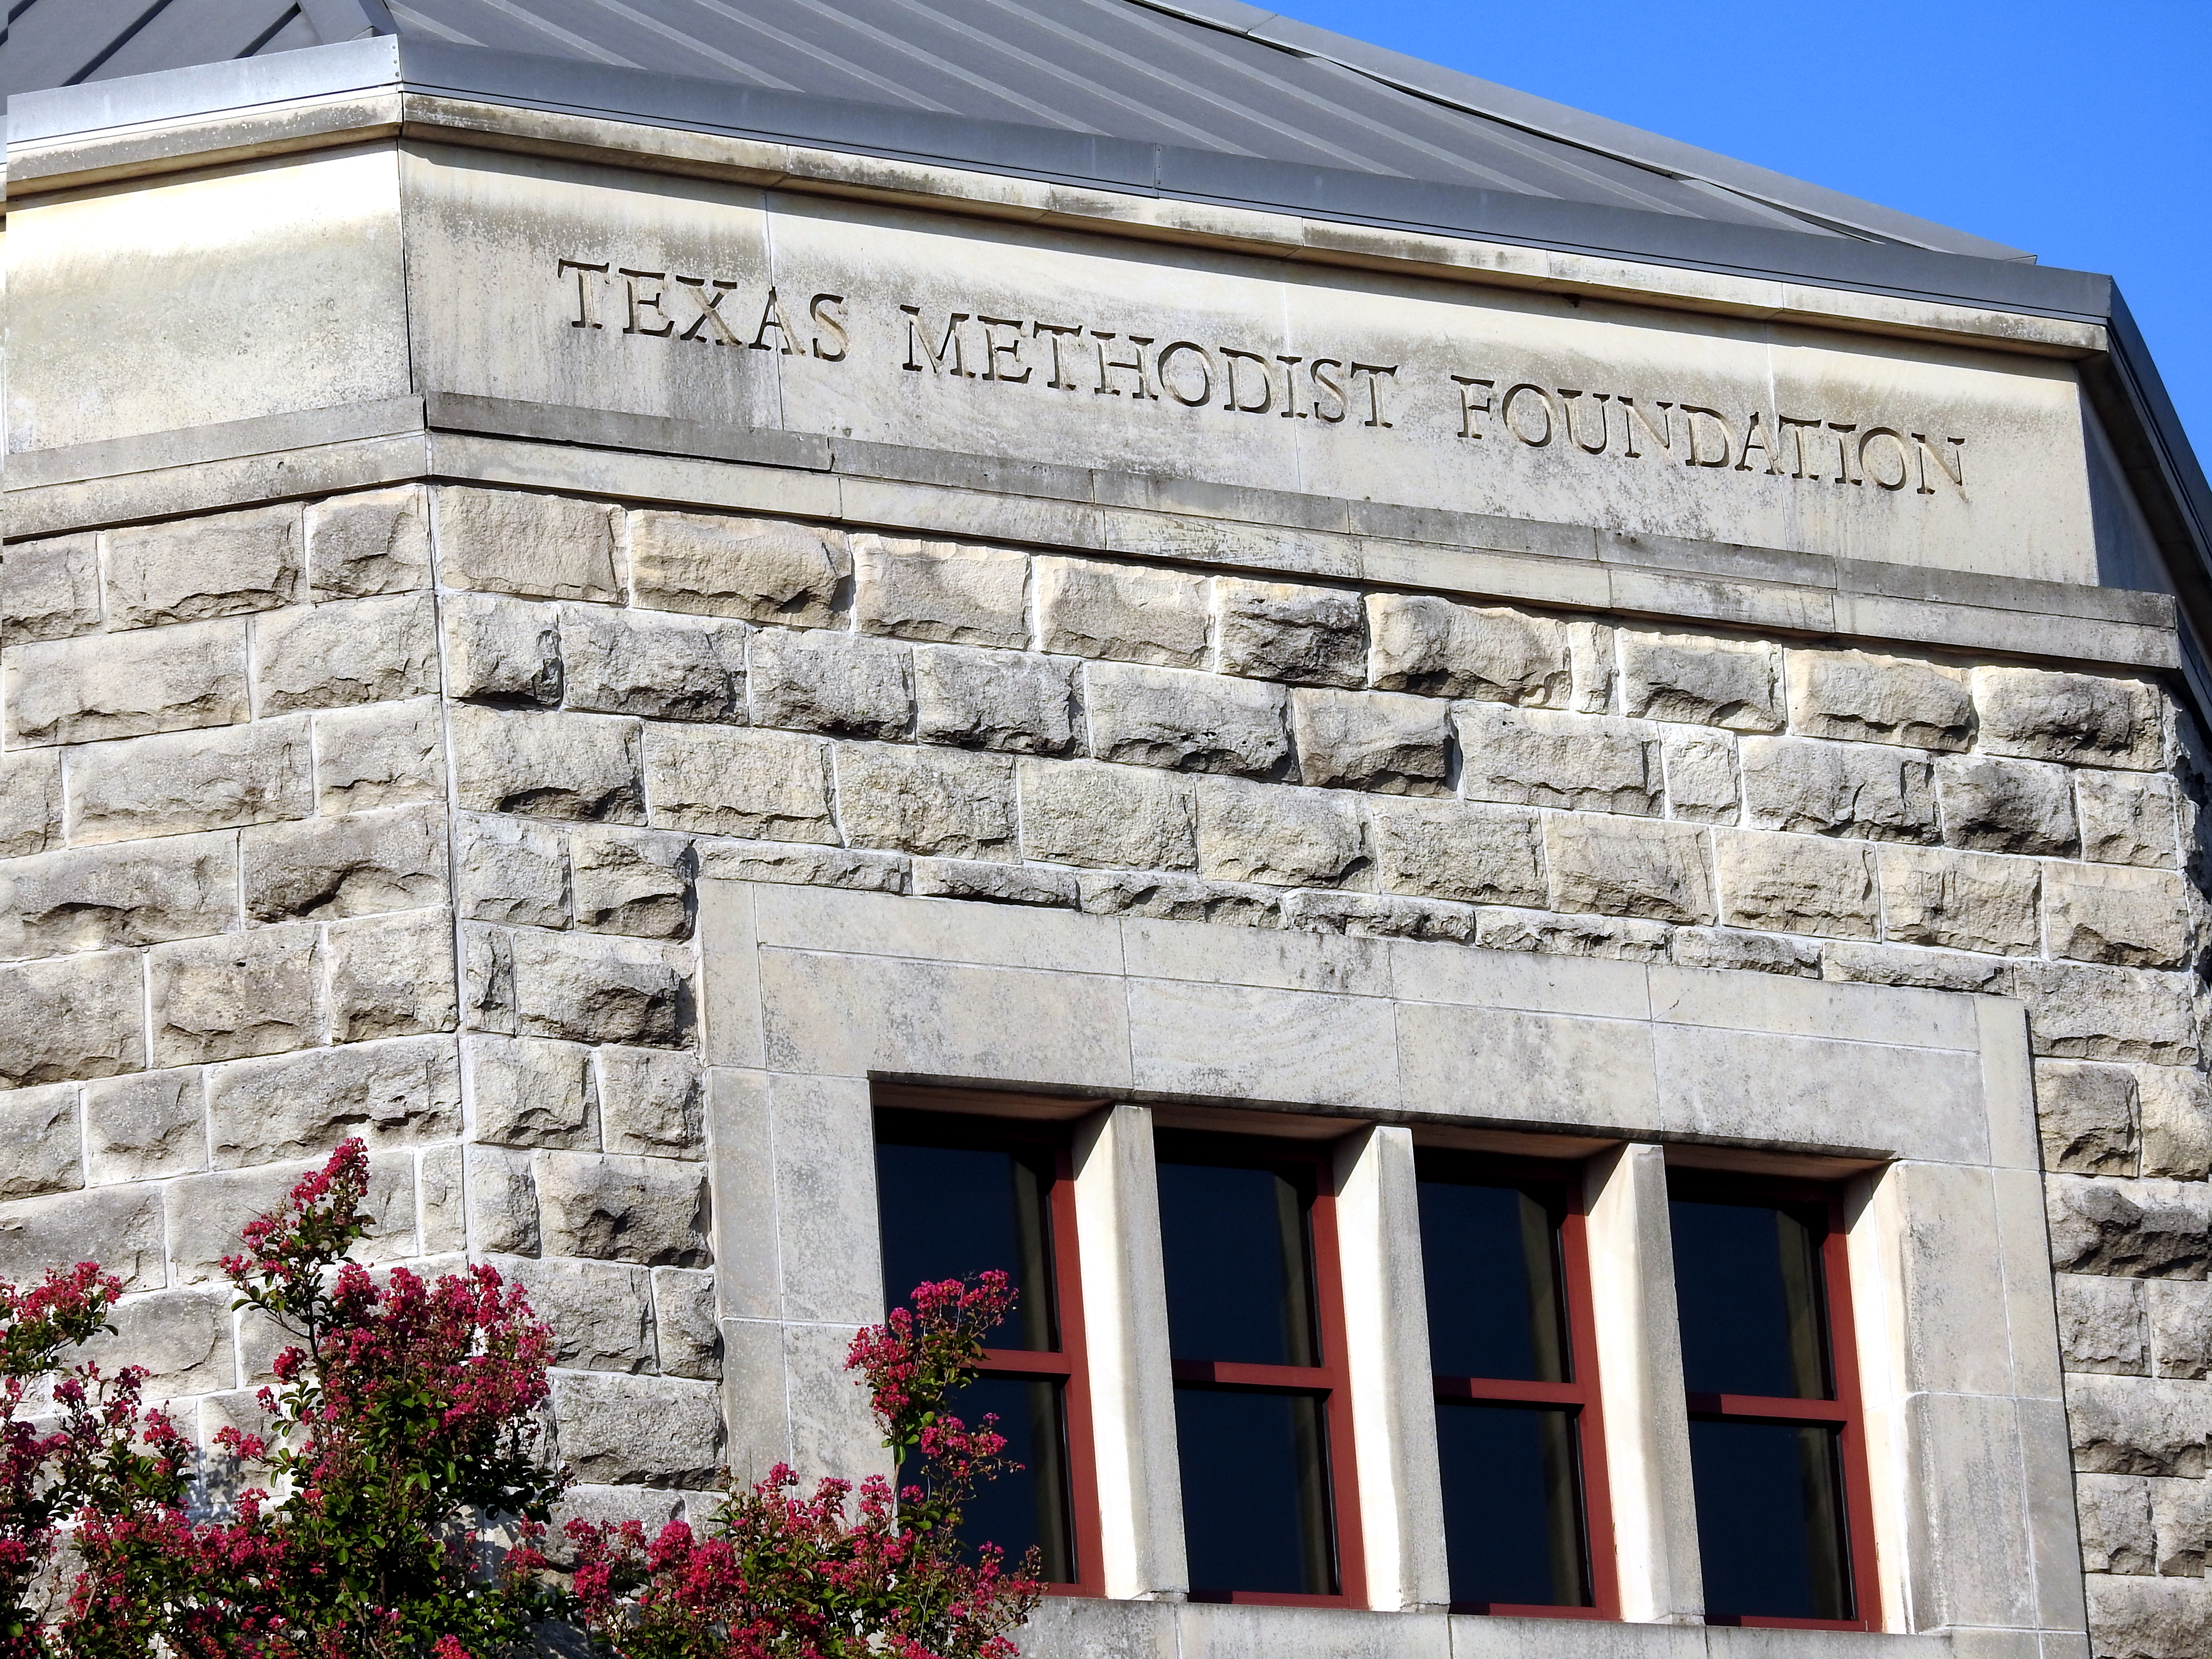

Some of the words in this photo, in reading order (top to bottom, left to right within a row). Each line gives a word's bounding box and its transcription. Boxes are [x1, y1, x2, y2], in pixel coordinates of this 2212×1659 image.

[558, 258, 851, 362] TEXAS
[900, 304, 1398, 429] METHODIST
[1451, 374, 1967, 503] FOUNDATION
